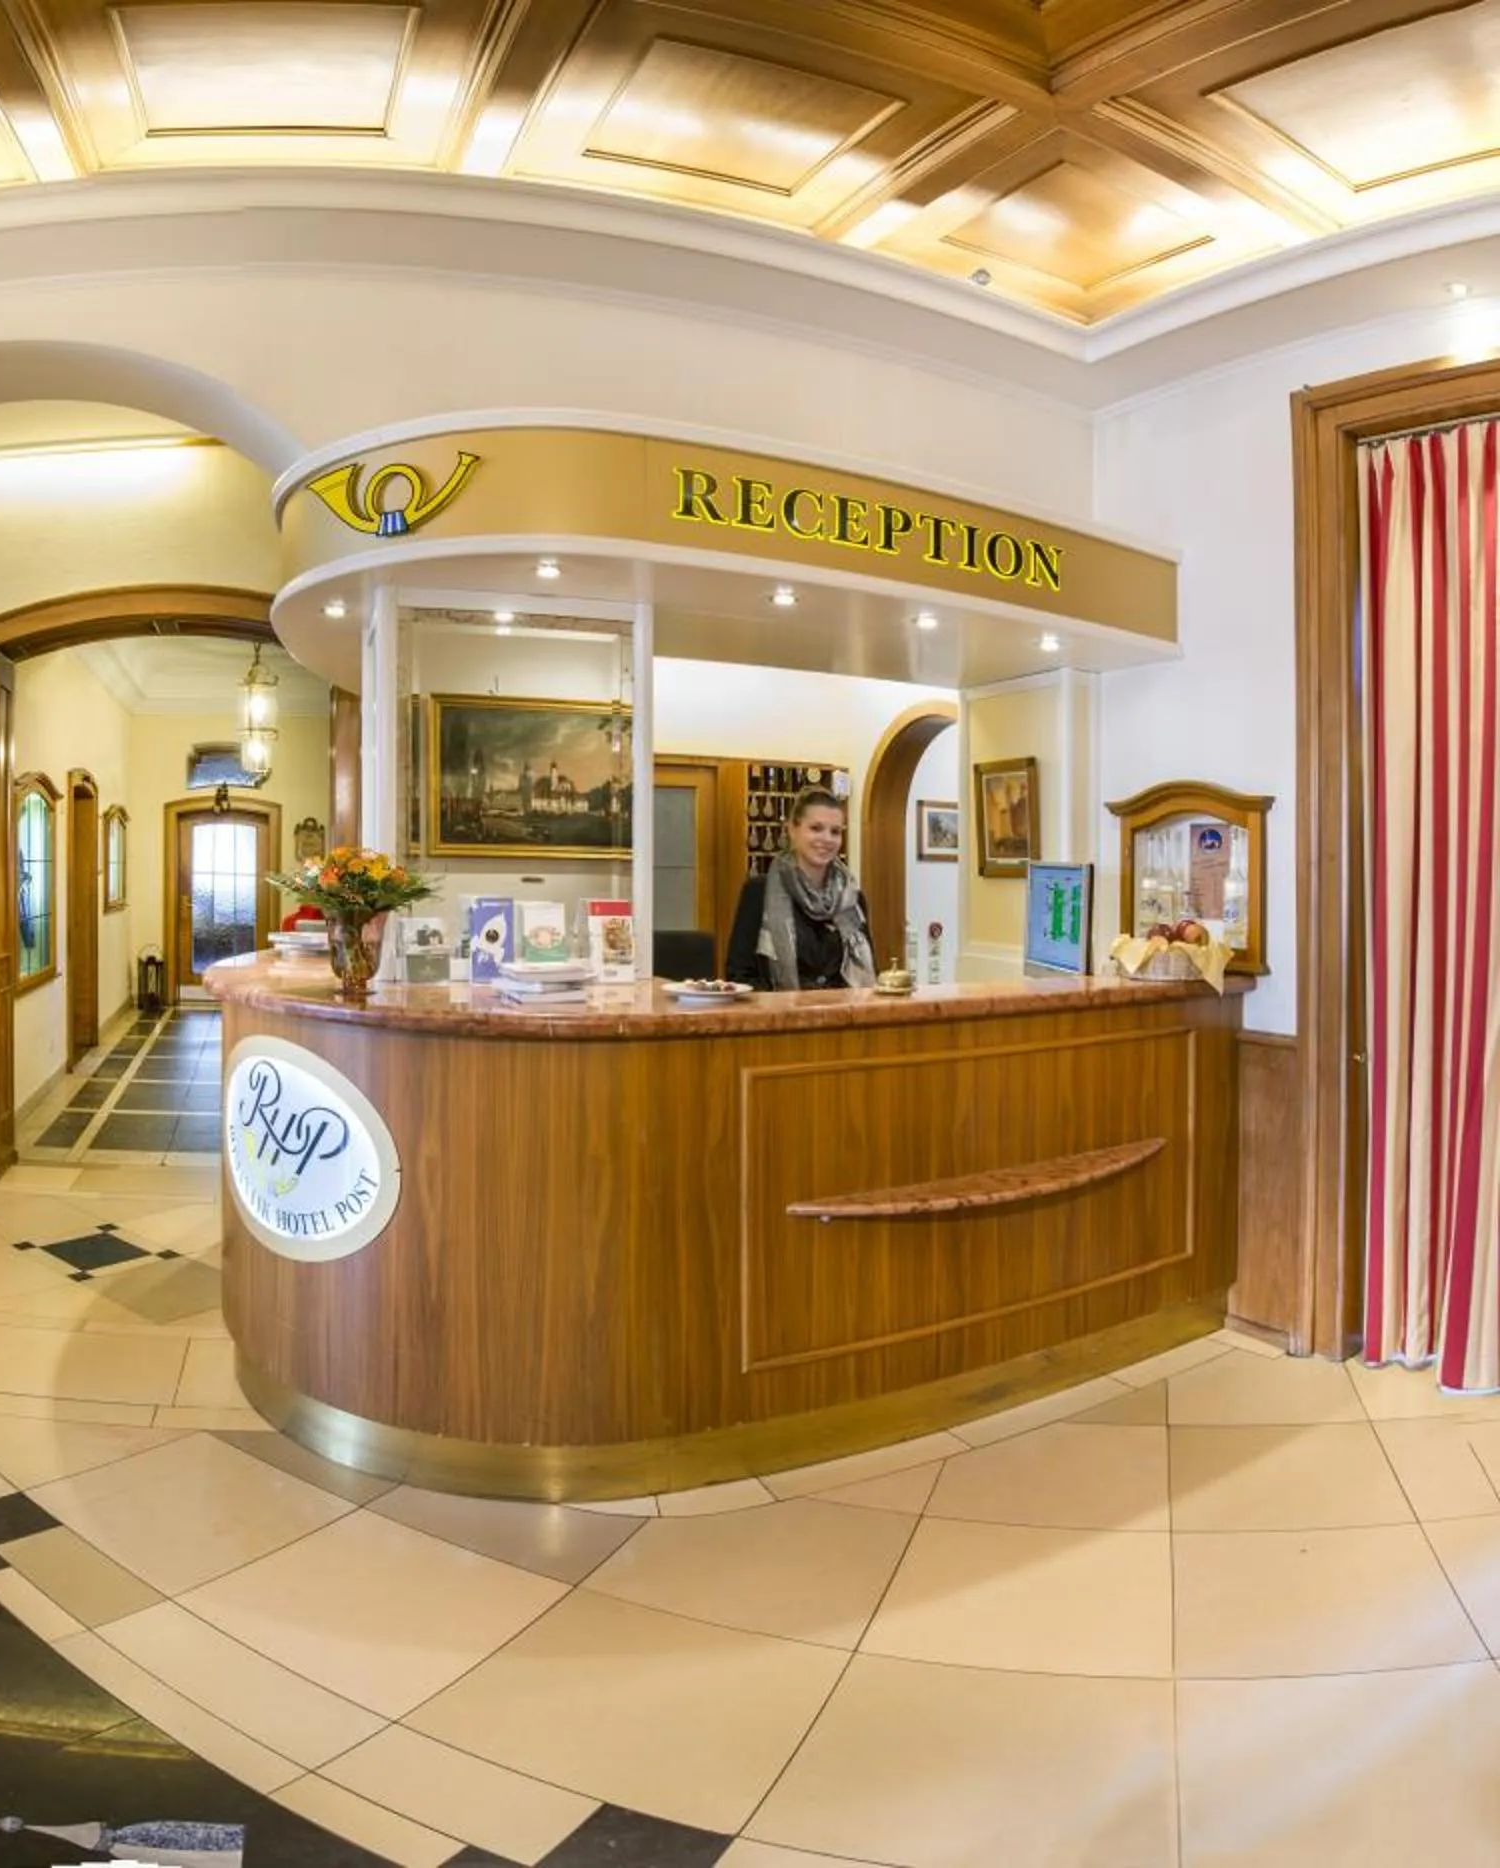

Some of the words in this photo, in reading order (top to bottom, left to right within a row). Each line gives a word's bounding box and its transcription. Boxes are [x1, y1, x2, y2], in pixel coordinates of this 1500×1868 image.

[672, 467, 1063, 592] RECEPTION
[275, 1208, 335, 1236] HOTEL
[335, 1168, 379, 1224] POST
